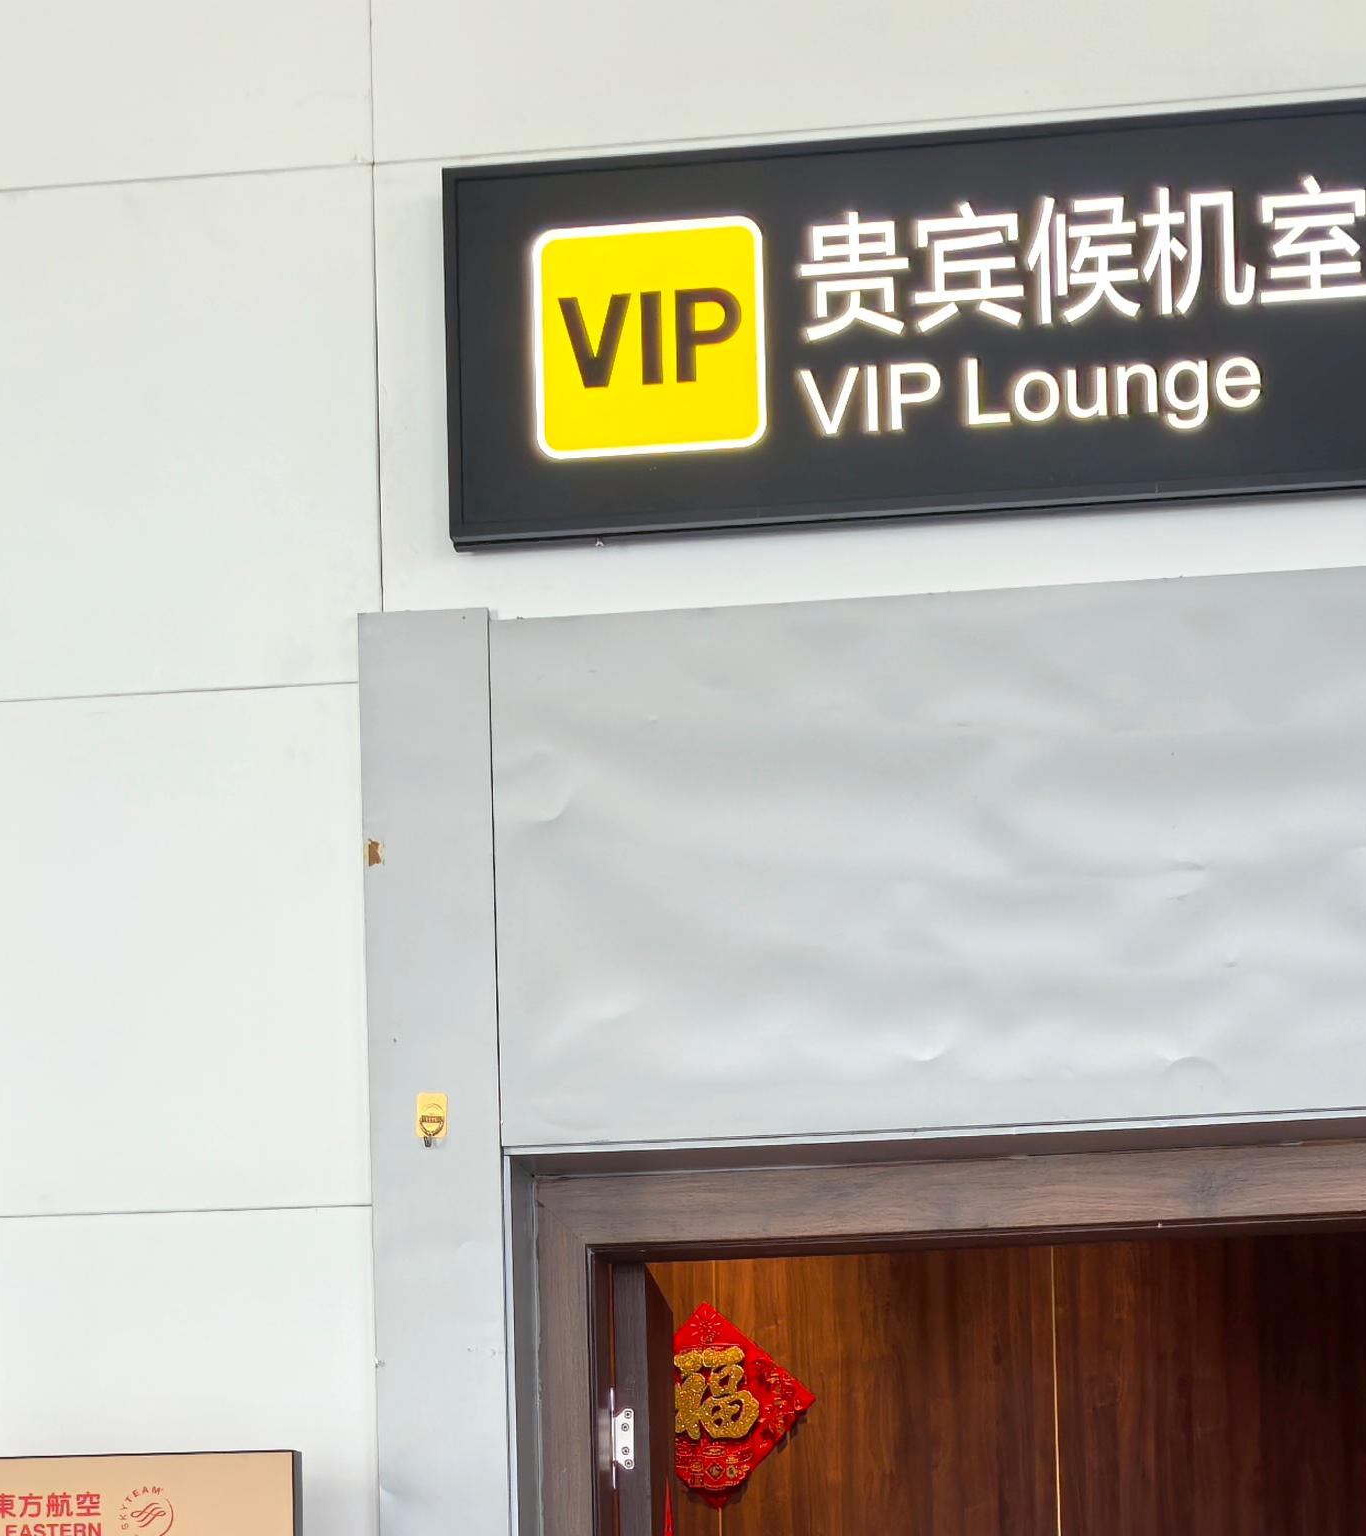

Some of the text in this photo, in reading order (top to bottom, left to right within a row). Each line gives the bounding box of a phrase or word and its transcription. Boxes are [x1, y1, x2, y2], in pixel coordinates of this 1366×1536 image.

[558, 285, 742, 389] VIP
[800, 350, 1263, 439] VIP Lounge
[117, 1485, 163, 1530] SKYTEAM
